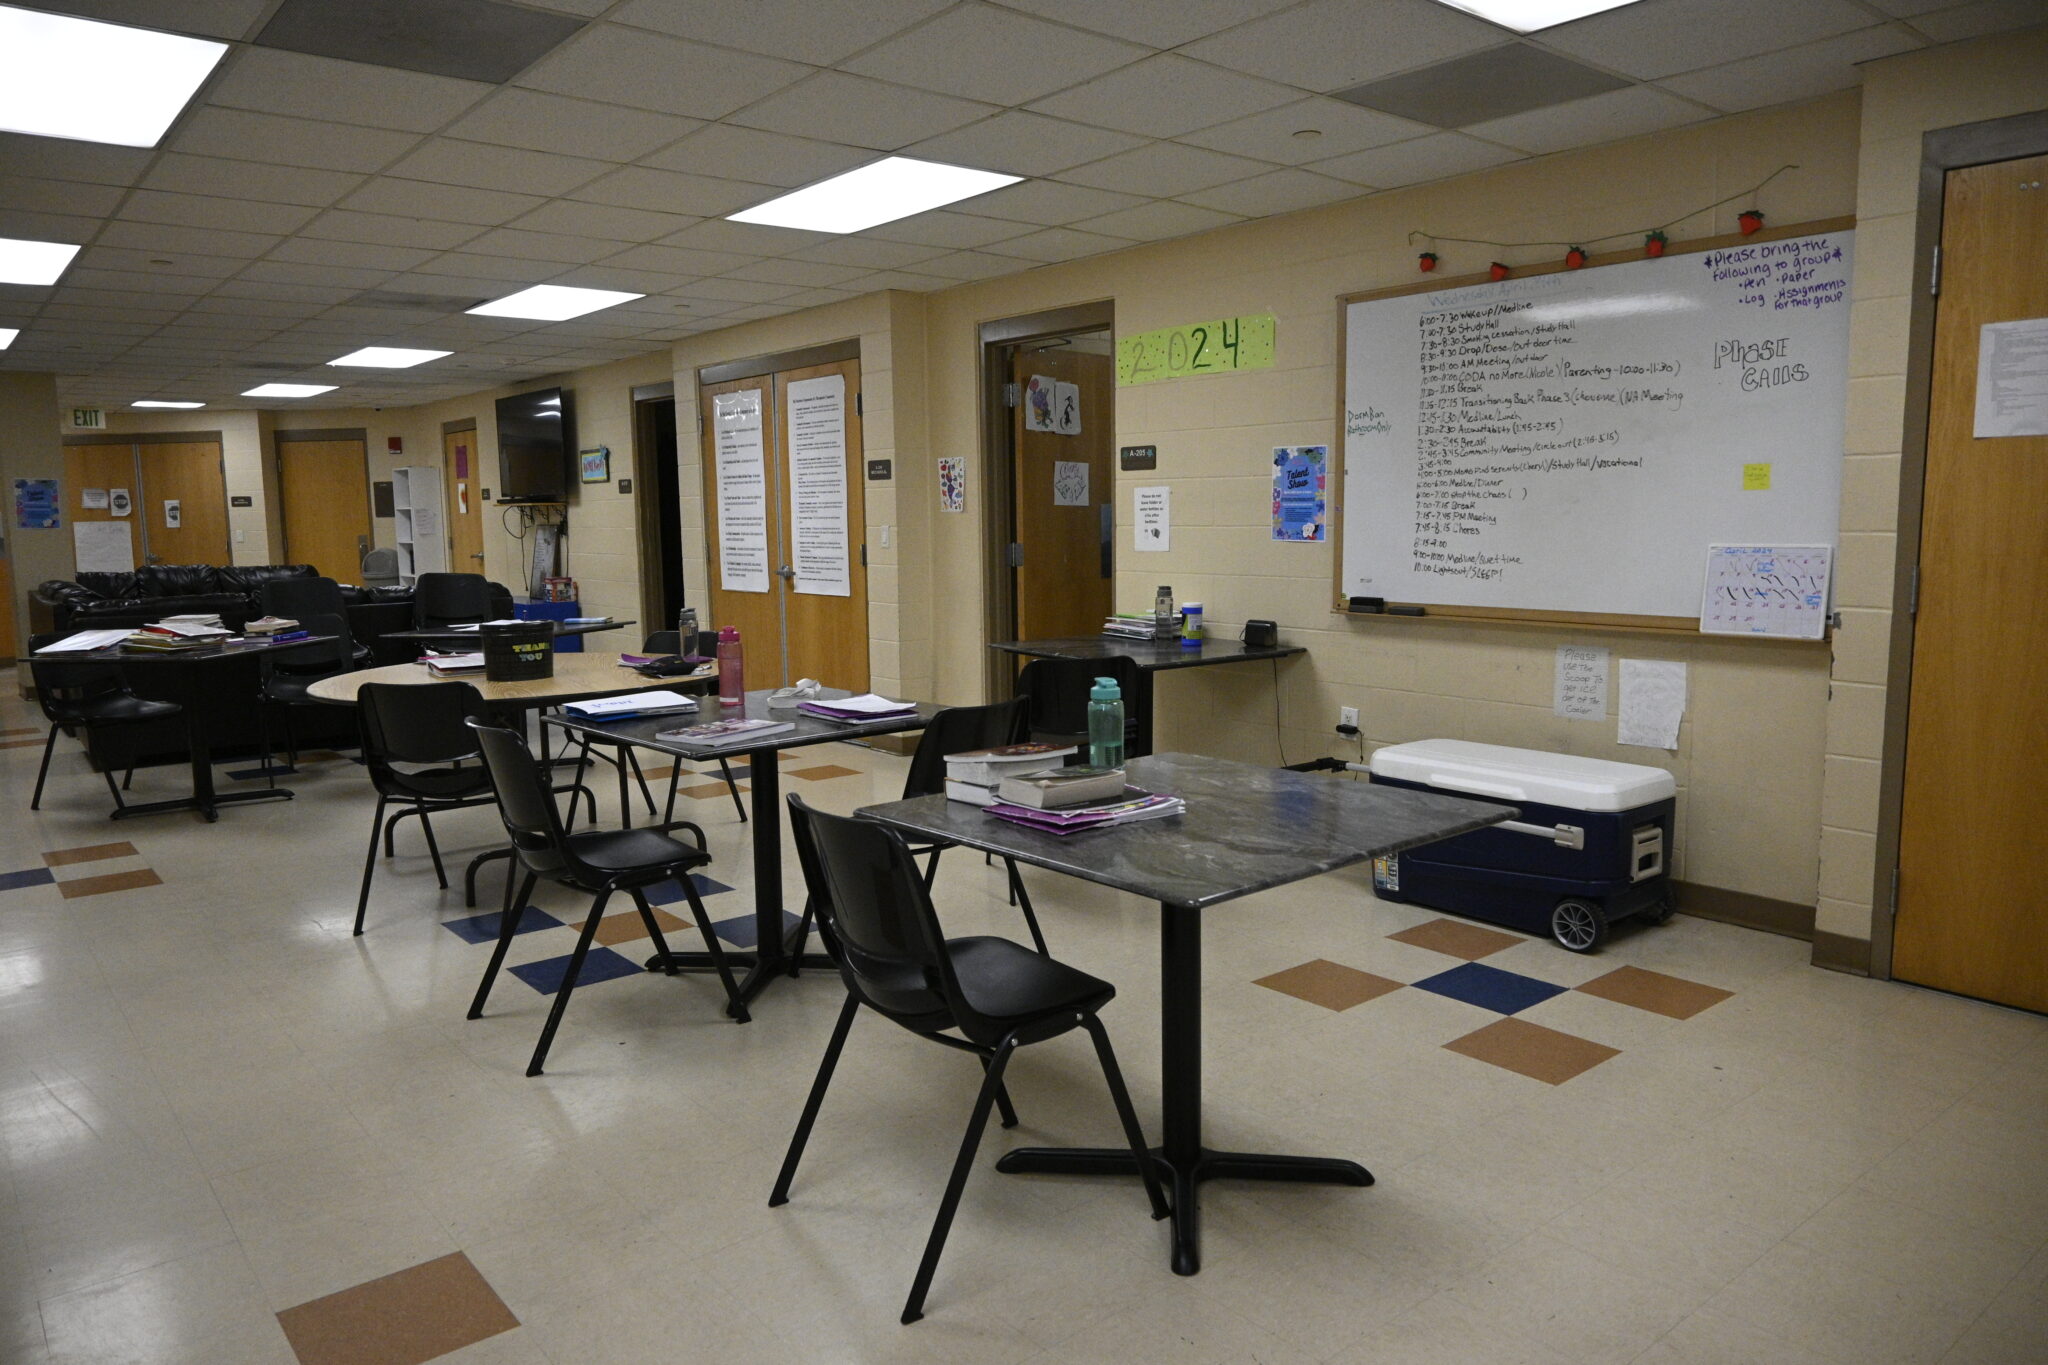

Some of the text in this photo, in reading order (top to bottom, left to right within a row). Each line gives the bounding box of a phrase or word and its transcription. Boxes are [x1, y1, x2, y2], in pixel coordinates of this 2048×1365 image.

[1715, 238, 1830, 267] Please bring the
[1775, 260, 1788, 270] to
[1745, 279, 1847, 308] Log Assignments
[1813, 291, 1843, 309] group
[1131, 317, 1240, 379] 2024
[1460, 358, 1475, 369] AM
[1459, 371, 1486, 382] CODA
[1458, 382, 1483, 393] Break
[73, 408, 100, 427] EXIT
[1460, 436, 1487, 449] Break
[1451, 500, 1476, 510] Break
[519, 652, 543, 662] YOU
